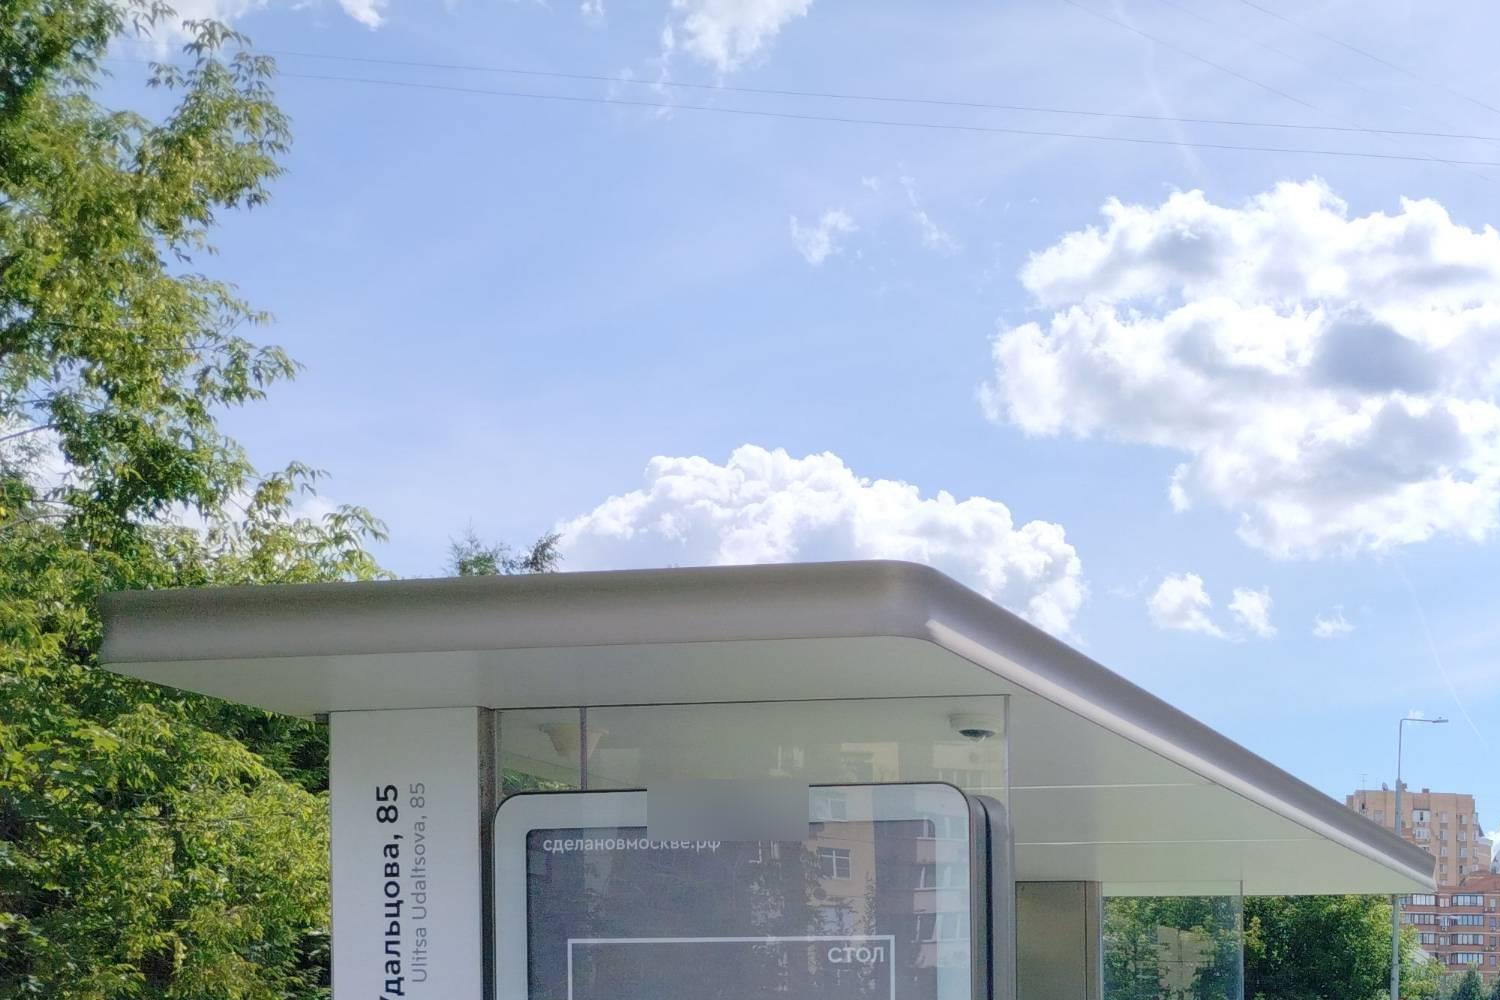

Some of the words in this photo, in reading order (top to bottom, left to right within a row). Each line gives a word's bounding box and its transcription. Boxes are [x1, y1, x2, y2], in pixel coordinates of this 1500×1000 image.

[375, 783, 400, 824] 85
[409, 782, 426, 809] 85
[410, 815, 428, 921] Udaltsova,
[410, 927, 428, 983] Ulitsa
[827, 946, 885, 963] СТОЛ
